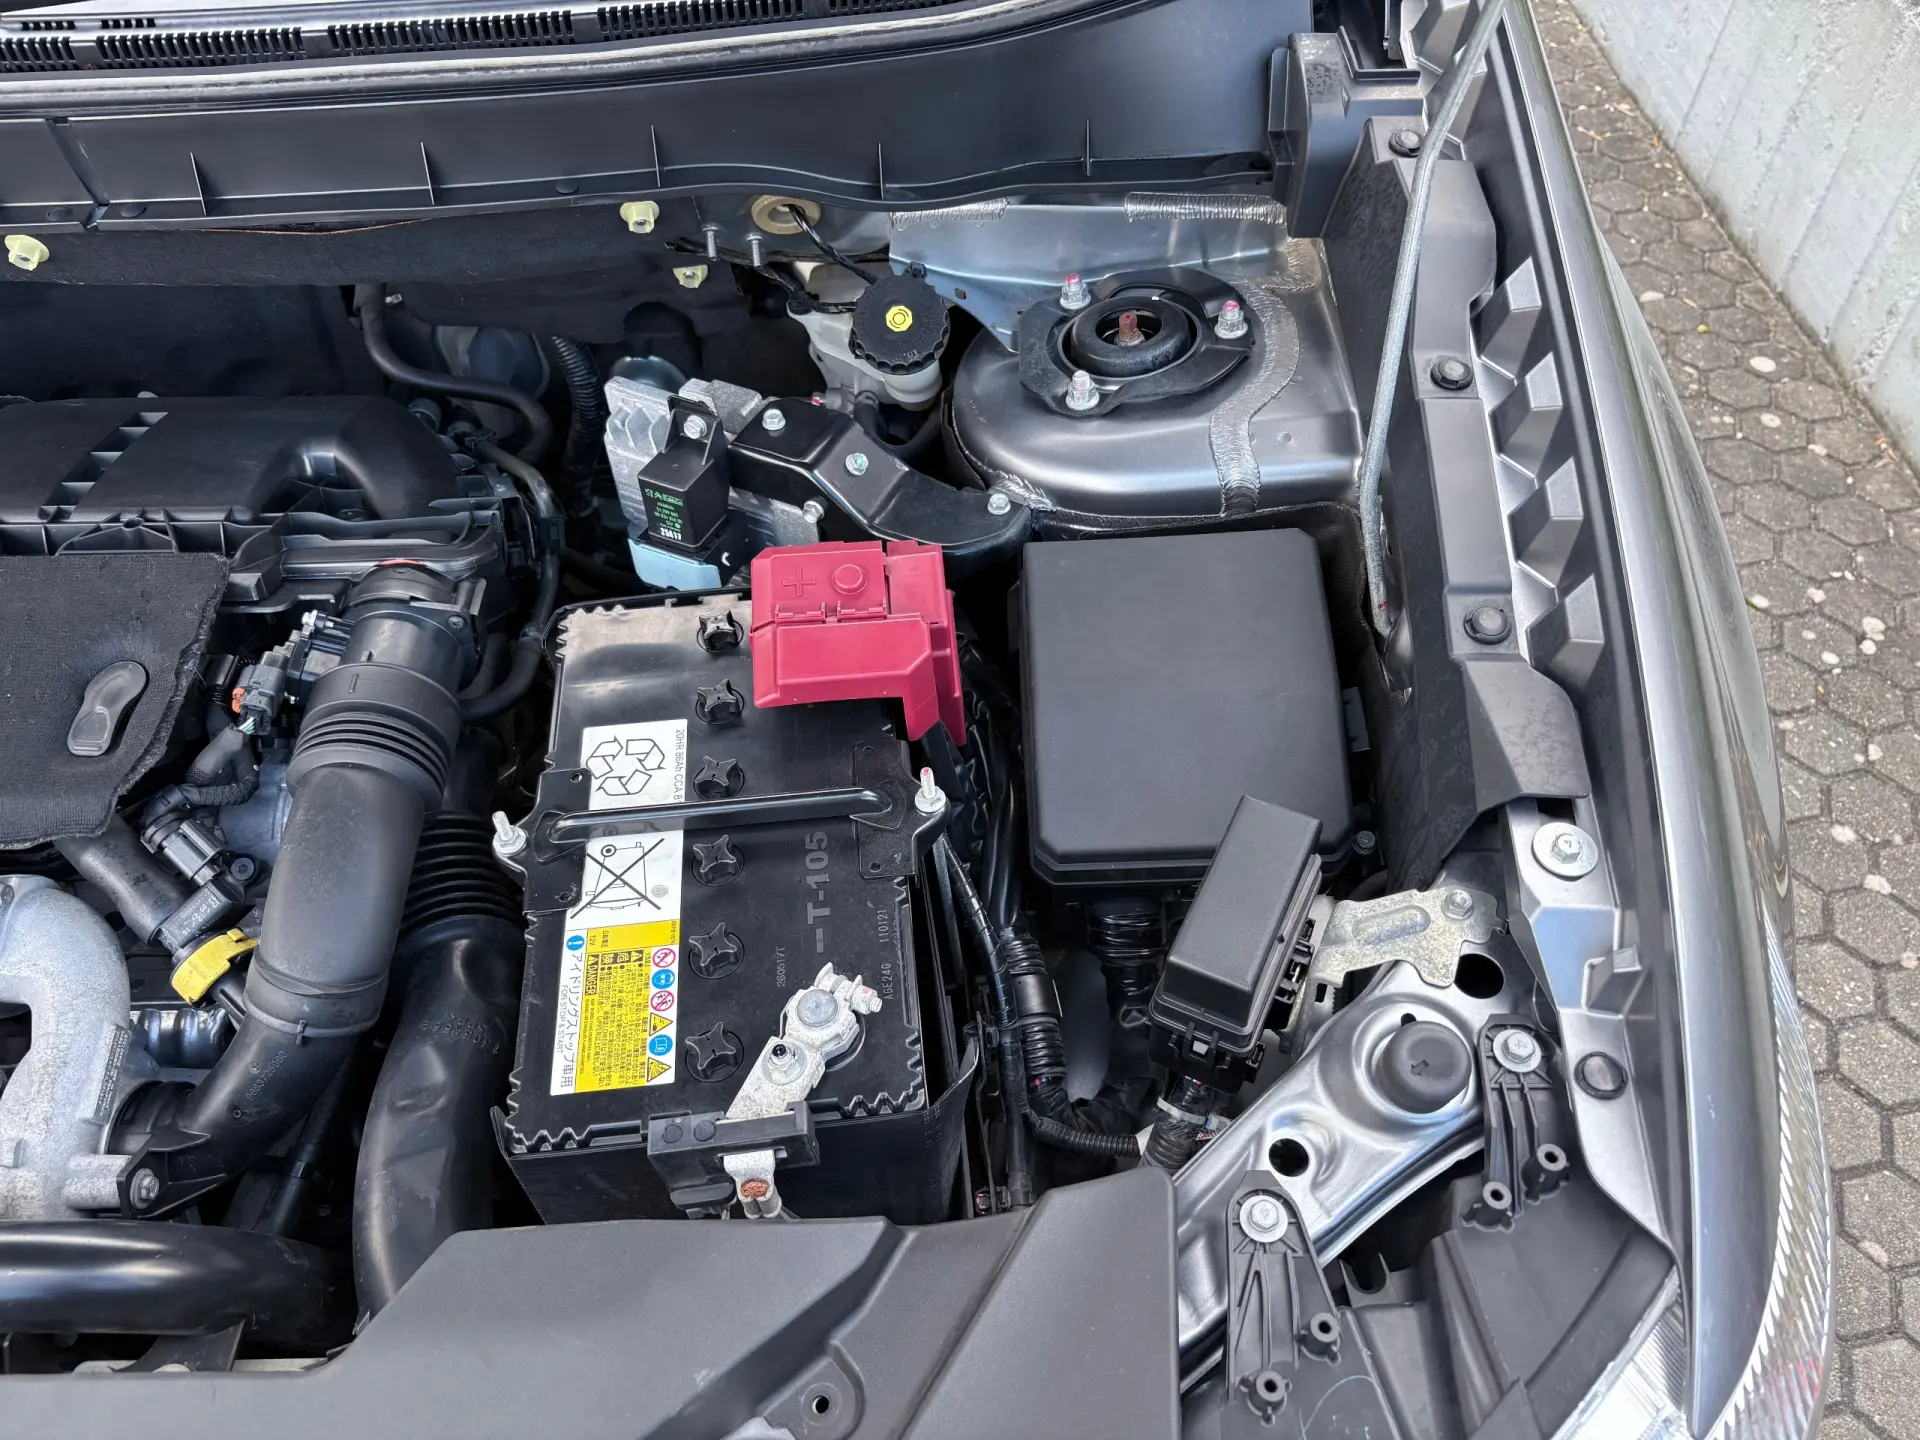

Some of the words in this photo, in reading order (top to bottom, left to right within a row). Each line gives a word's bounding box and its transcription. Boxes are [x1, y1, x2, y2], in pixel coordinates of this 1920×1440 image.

[675, 729, 685, 750] 20HR
[674, 752, 684, 772] 86Ah
[674, 774, 683, 793] CCA
[877, 910, 889, 942] 110121
[600, 951, 629, 965] 危険
[584, 964, 597, 995] DANGER
[558, 1001, 566, 1022] STOP
[560, 952, 583, 1087] アイドリングストップ車用
[556, 1029, 564, 1053] START
